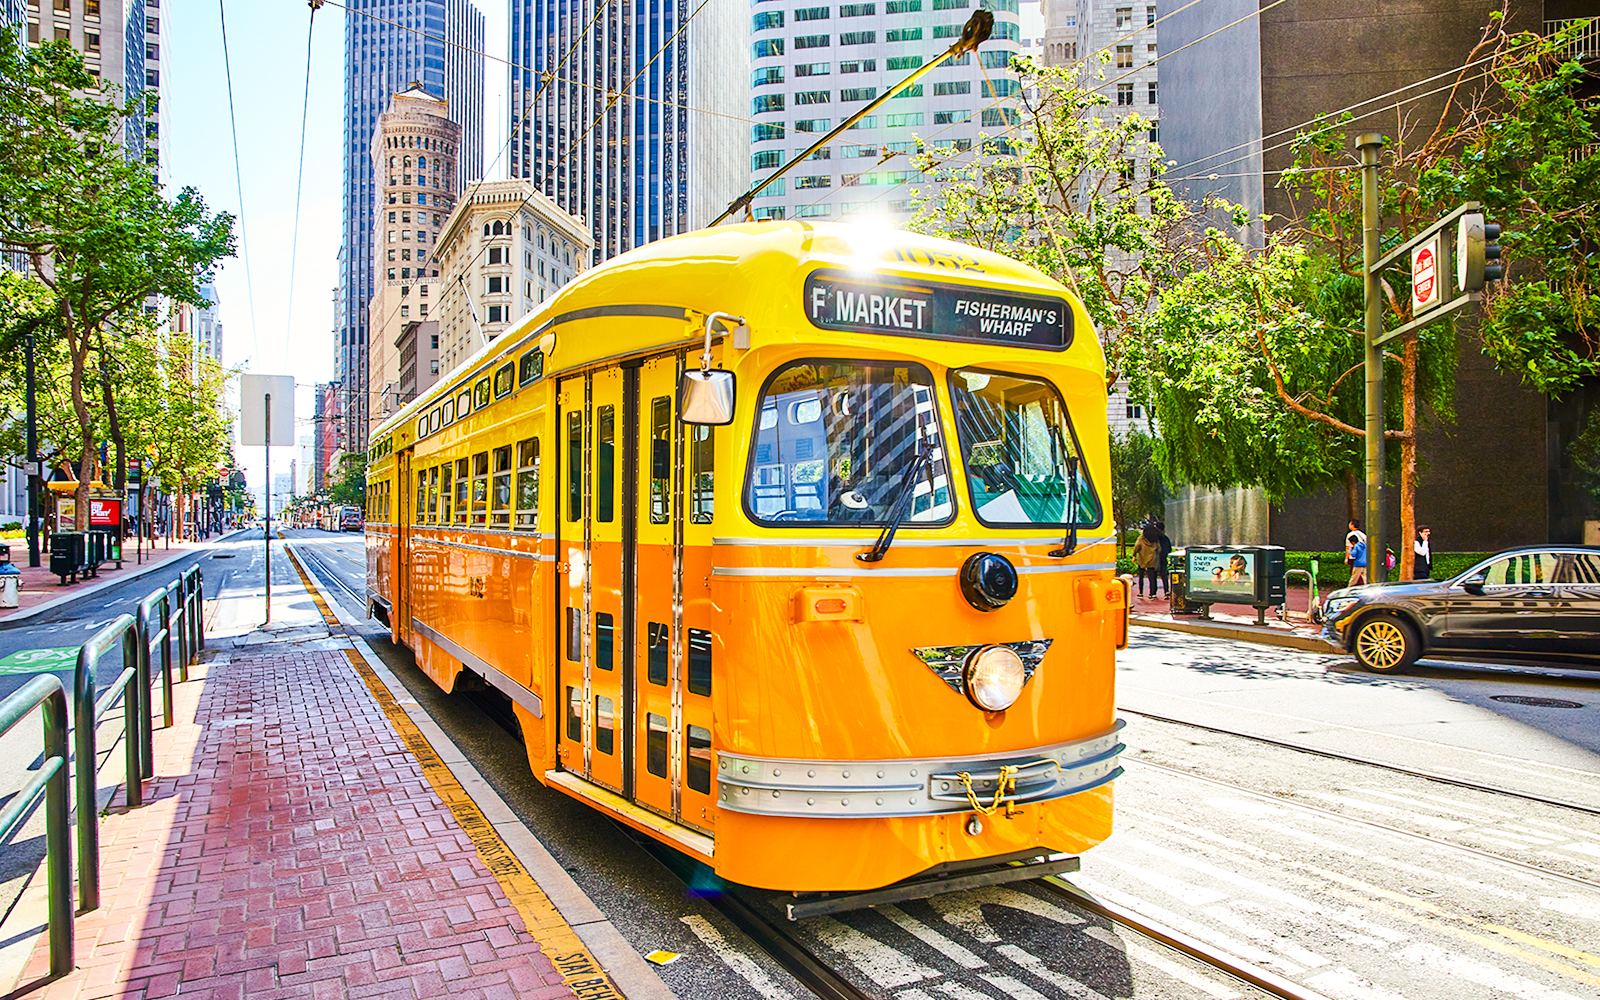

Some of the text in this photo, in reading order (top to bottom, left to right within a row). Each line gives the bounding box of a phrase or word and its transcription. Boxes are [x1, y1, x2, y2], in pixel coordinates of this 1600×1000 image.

[893, 246, 985, 274] 1052
[812, 286, 927, 330] F MARKET
[954, 299, 1057, 325] FISHERMAN'S
[979, 317, 1034, 337] WHARF
[554, 952, 598, 977] STAY
